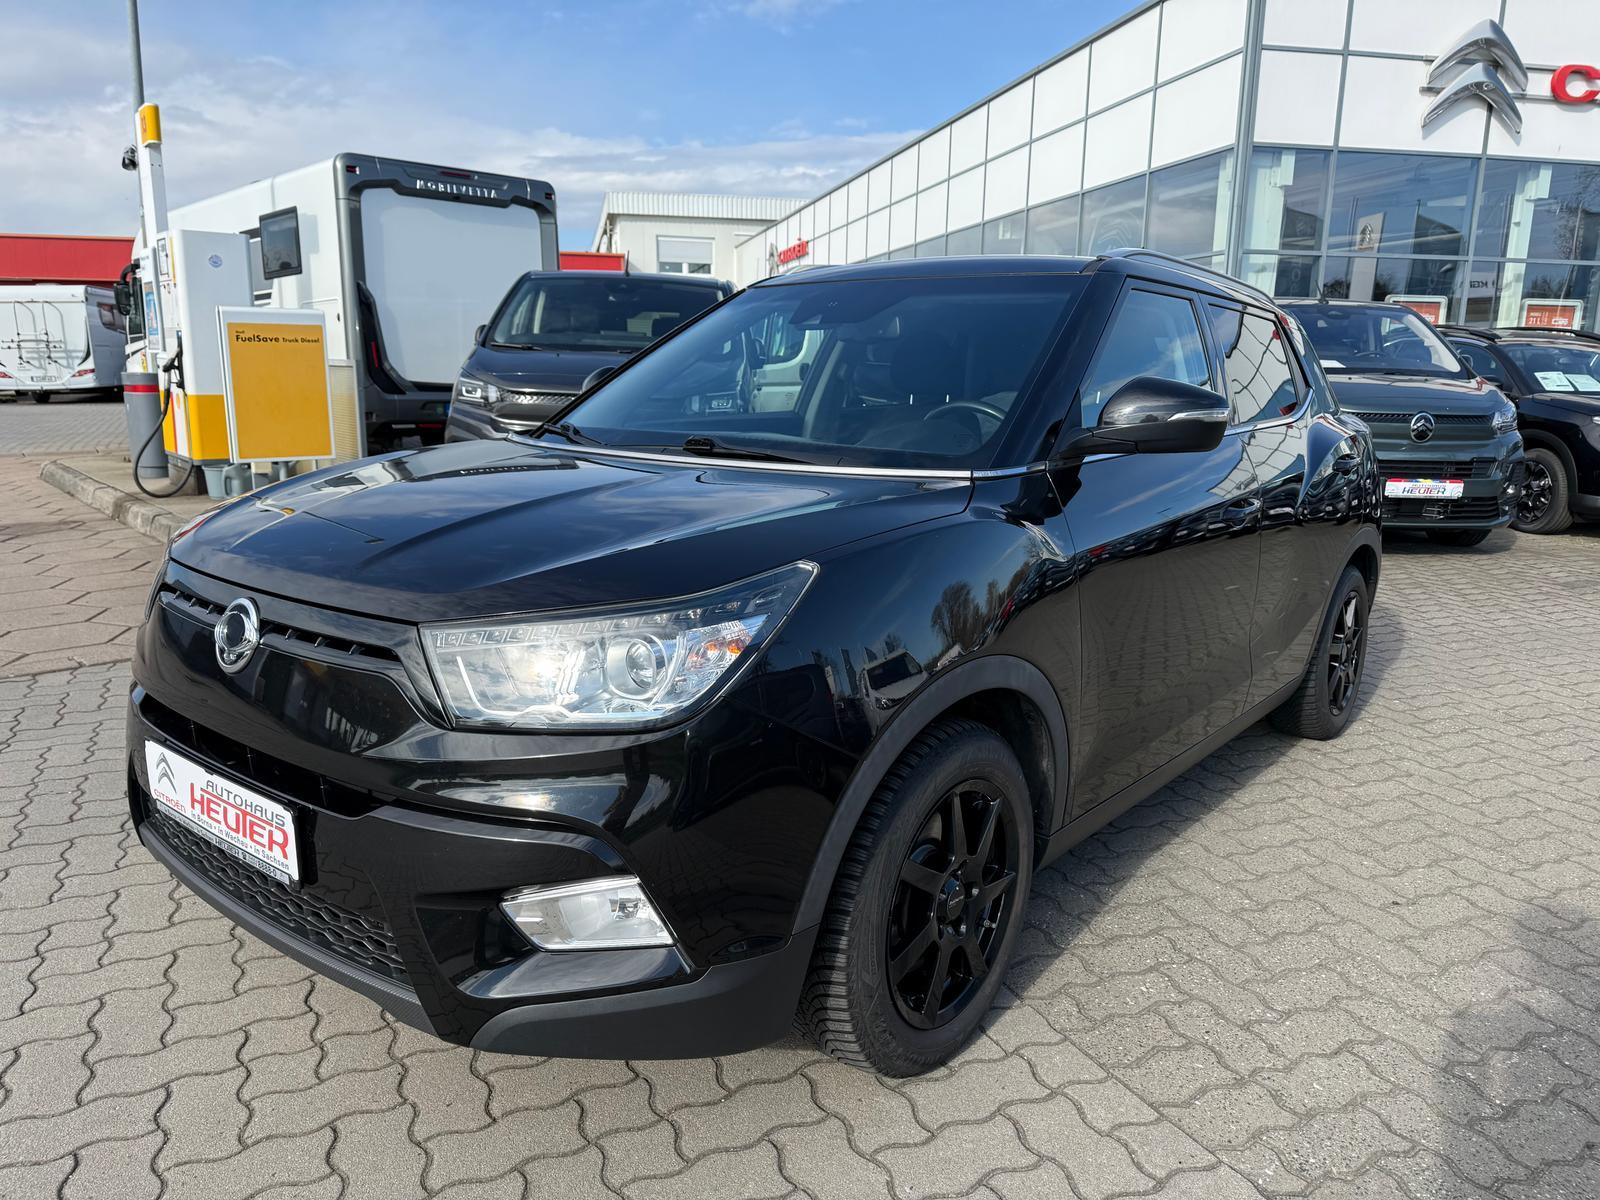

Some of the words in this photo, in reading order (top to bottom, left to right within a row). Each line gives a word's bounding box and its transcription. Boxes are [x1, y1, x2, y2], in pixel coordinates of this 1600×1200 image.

[416, 179, 498, 199] MOBILVETTA
[235, 334, 280, 343] FuelSave
[206, 779, 285, 828] AUTOHAUS
[190, 782, 289, 861] HEUTER
[262, 849, 289, 870] Sachsen
